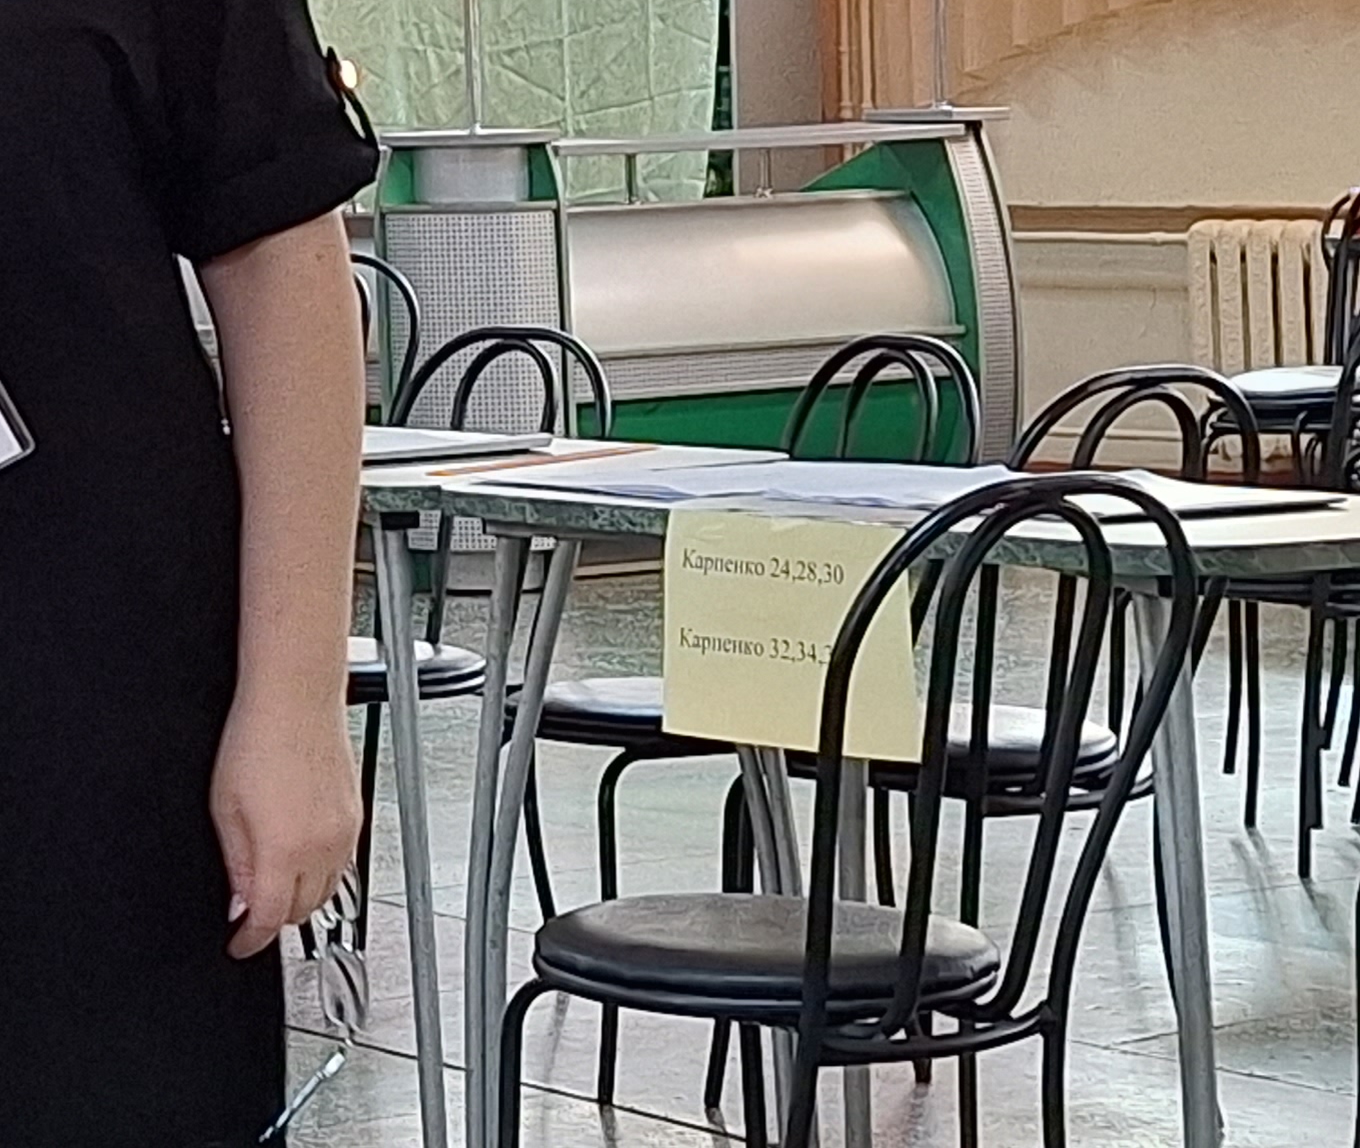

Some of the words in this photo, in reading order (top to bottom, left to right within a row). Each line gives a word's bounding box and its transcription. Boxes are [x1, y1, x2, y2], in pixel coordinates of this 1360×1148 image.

[682, 547, 766, 576] Карпенко
[769, 557, 845, 586] 24,28,30
[679, 626, 765, 657] Карпенко
[768, 637, 833, 665] 32,34,3
